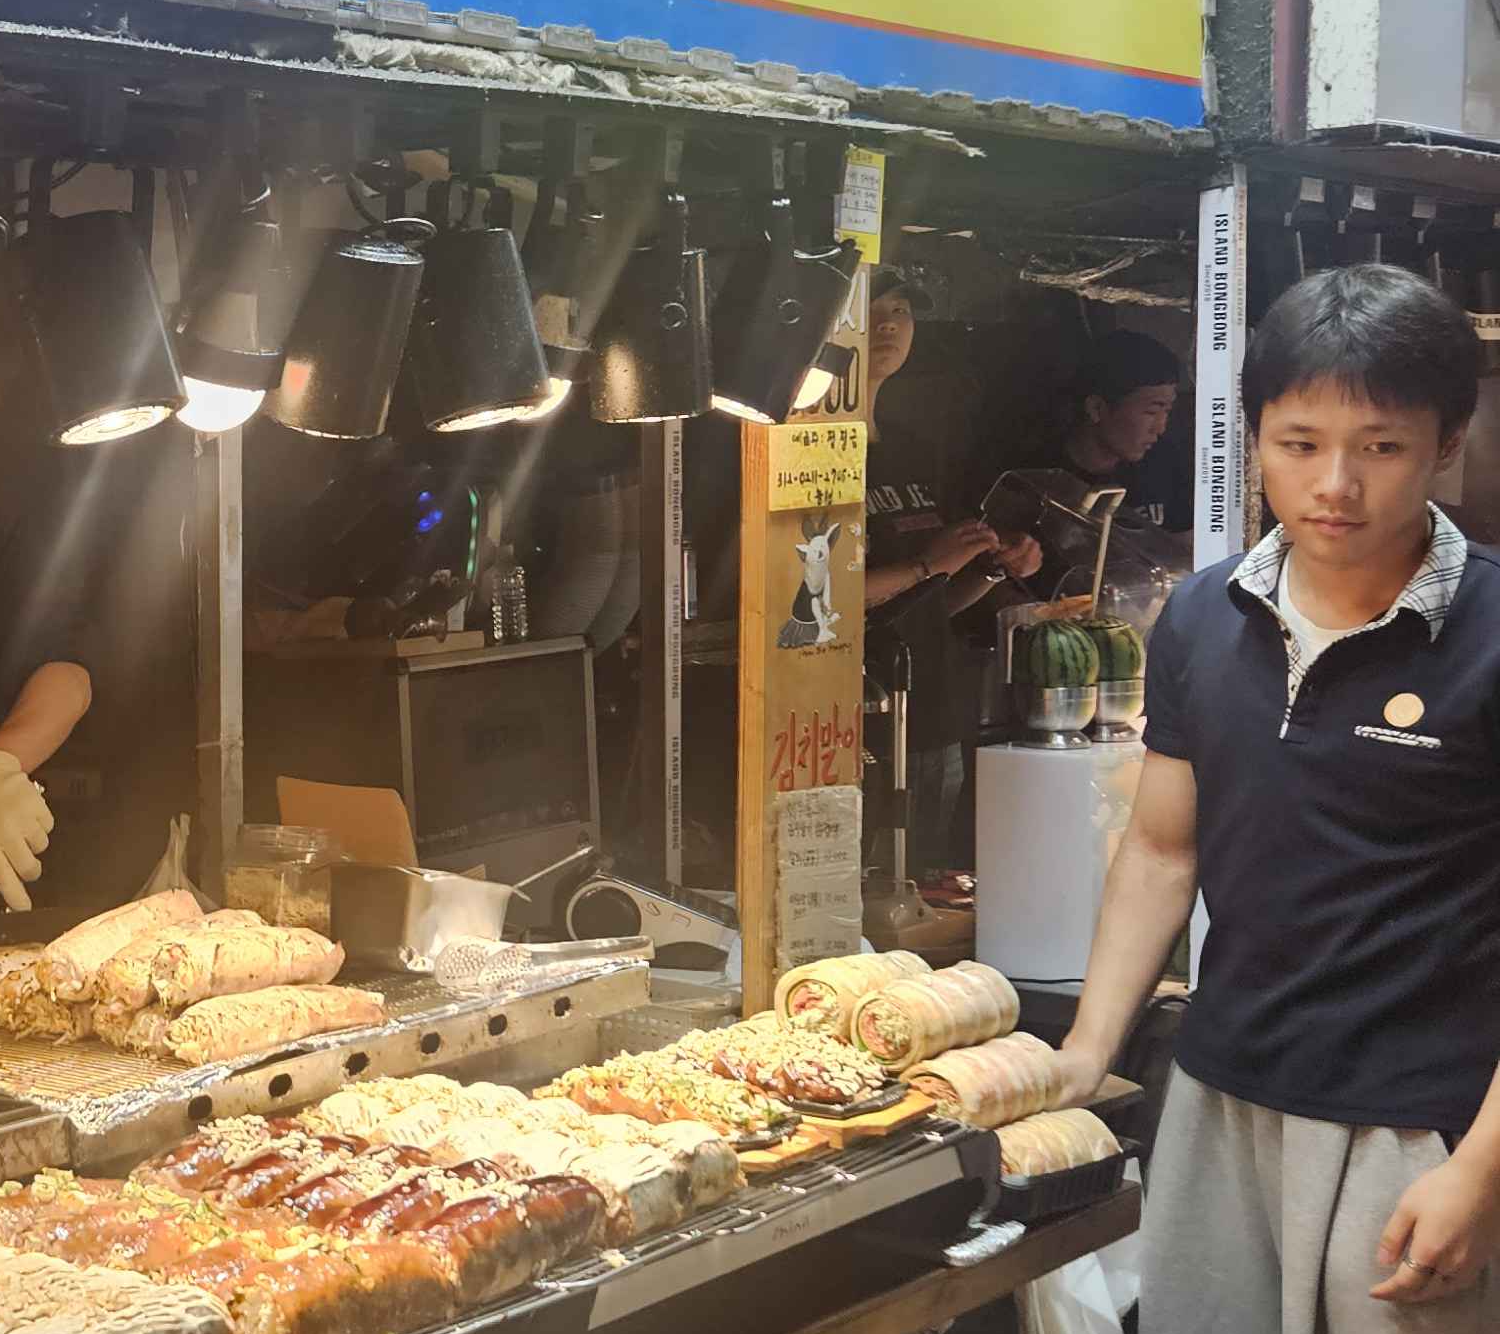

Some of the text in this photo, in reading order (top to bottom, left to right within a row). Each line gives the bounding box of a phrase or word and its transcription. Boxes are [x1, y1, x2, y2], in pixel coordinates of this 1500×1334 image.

[1213, 213, 1228, 351] ISLAND BONGBONG
[1210, 397, 1226, 533] ISLAND BONGBONG
[770, 702, 862, 792] 김치말이
